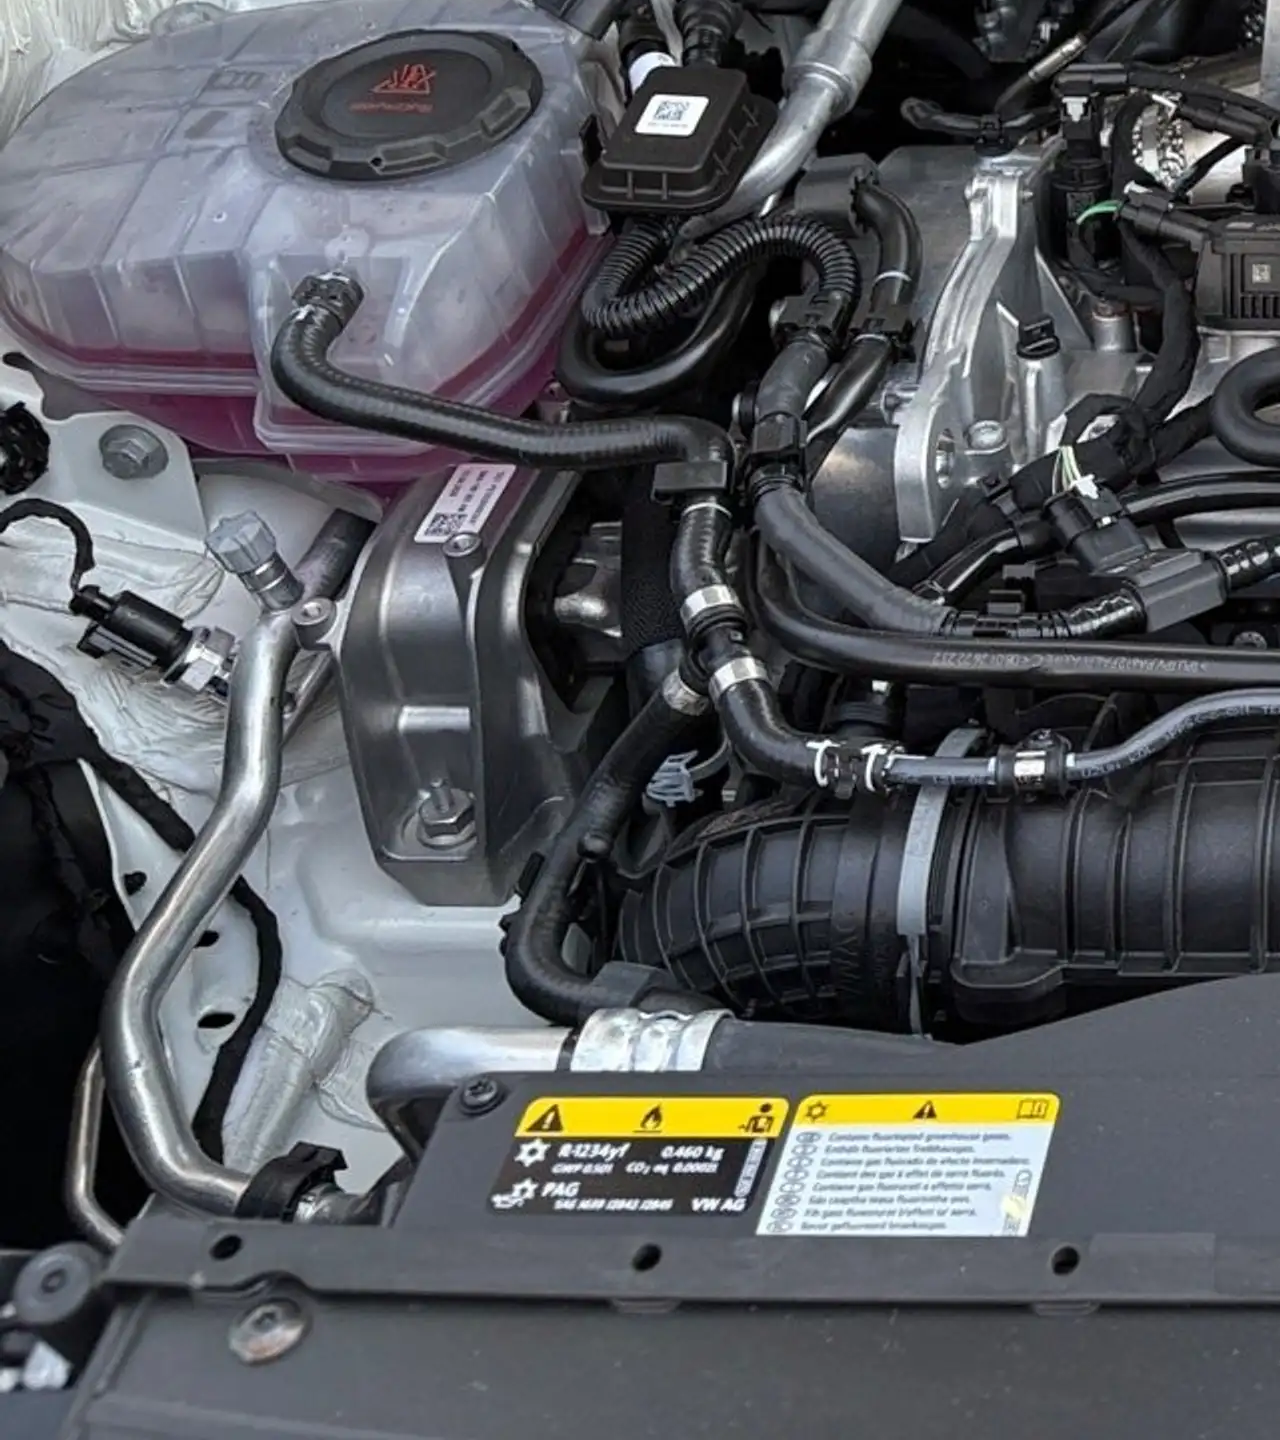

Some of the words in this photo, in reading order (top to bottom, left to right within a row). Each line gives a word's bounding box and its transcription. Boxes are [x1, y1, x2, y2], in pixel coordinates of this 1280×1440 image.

[541, 1181, 582, 1197] PAG
[691, 1197, 722, 1212] VW
[720, 1197, 747, 1212] AG
